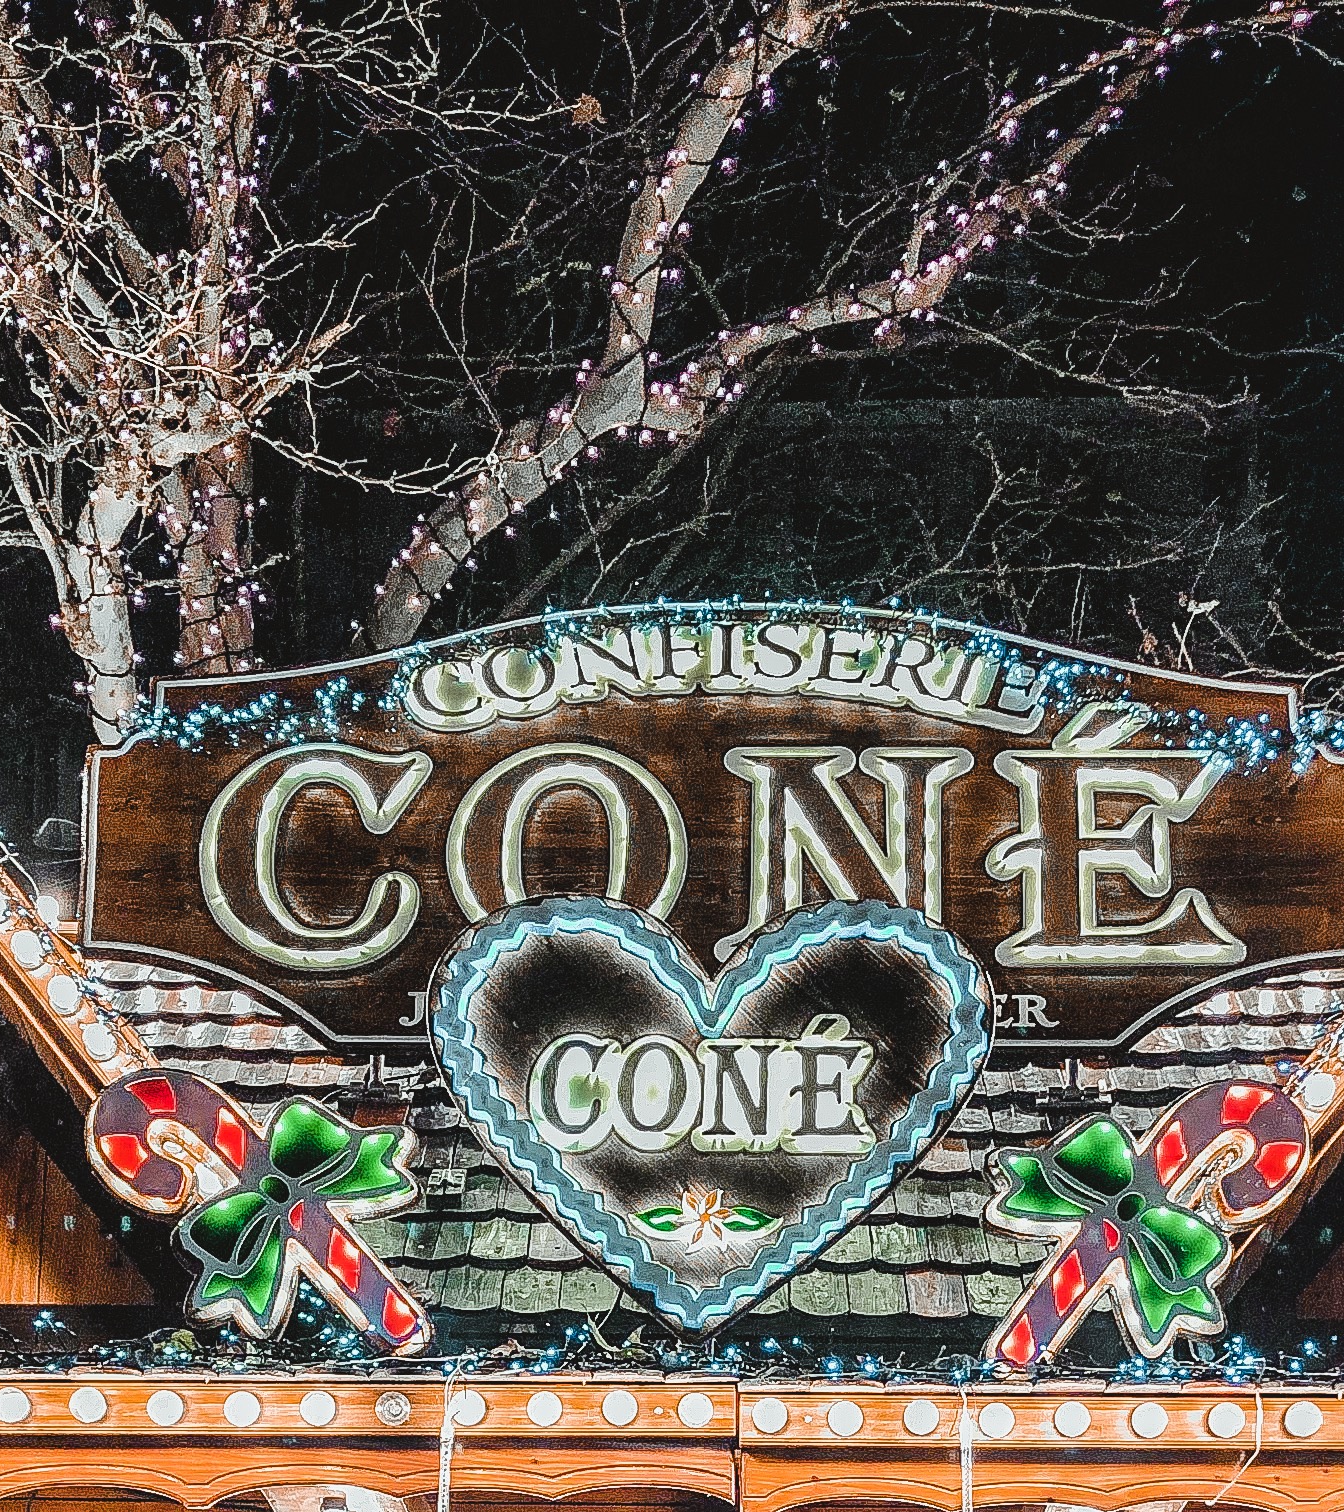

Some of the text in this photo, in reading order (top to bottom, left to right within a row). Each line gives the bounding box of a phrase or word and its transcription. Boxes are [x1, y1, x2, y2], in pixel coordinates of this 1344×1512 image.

[411, 620, 1042, 718] CONFISERIE
[200, 702, 1248, 968] CONÉ
[538, 1020, 874, 1146] CONÉ
